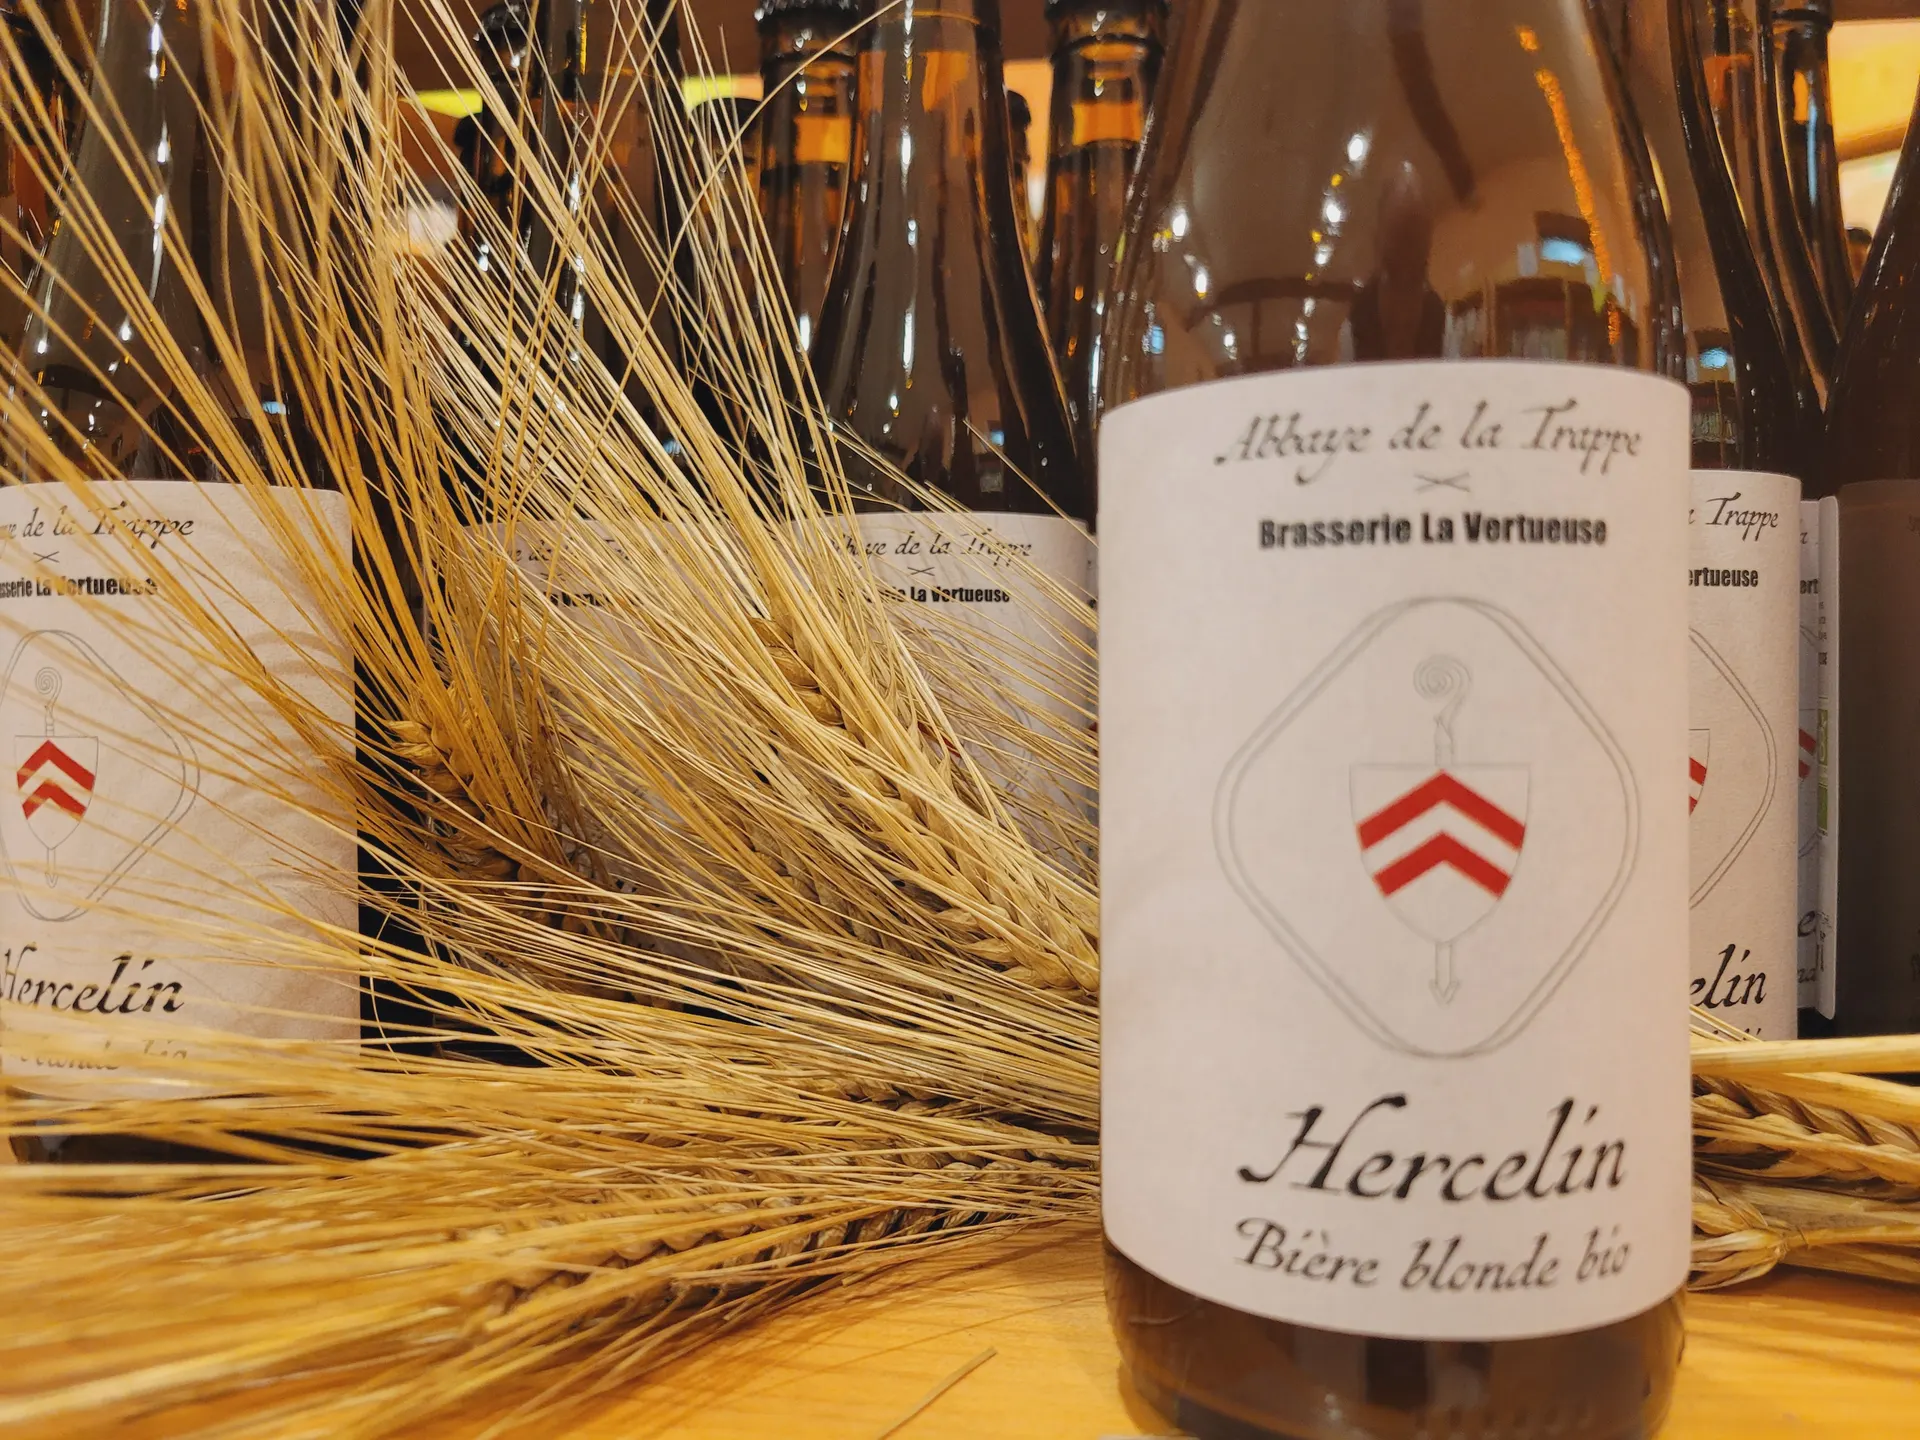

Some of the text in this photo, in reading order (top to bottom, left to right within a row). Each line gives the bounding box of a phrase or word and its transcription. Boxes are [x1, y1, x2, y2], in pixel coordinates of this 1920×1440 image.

[1388, 402, 1442, 451] de
[1460, 397, 1502, 449] la
[1520, 397, 1642, 476] Trappe
[22, 506, 44, 538] de
[1259, 510, 1608, 549] Brasserie La Vertueuse
[1705, 491, 1778, 541] Trappe
[895, 530, 920, 555] de
[56, 575, 158, 597] ertueue
[910, 586, 927, 603] La
[931, 586, 1010, 603] Vertueuse
[1237, 1093, 1628, 1204] Hercelin
[1234, 1216, 1632, 1292] Bière blonde bio
